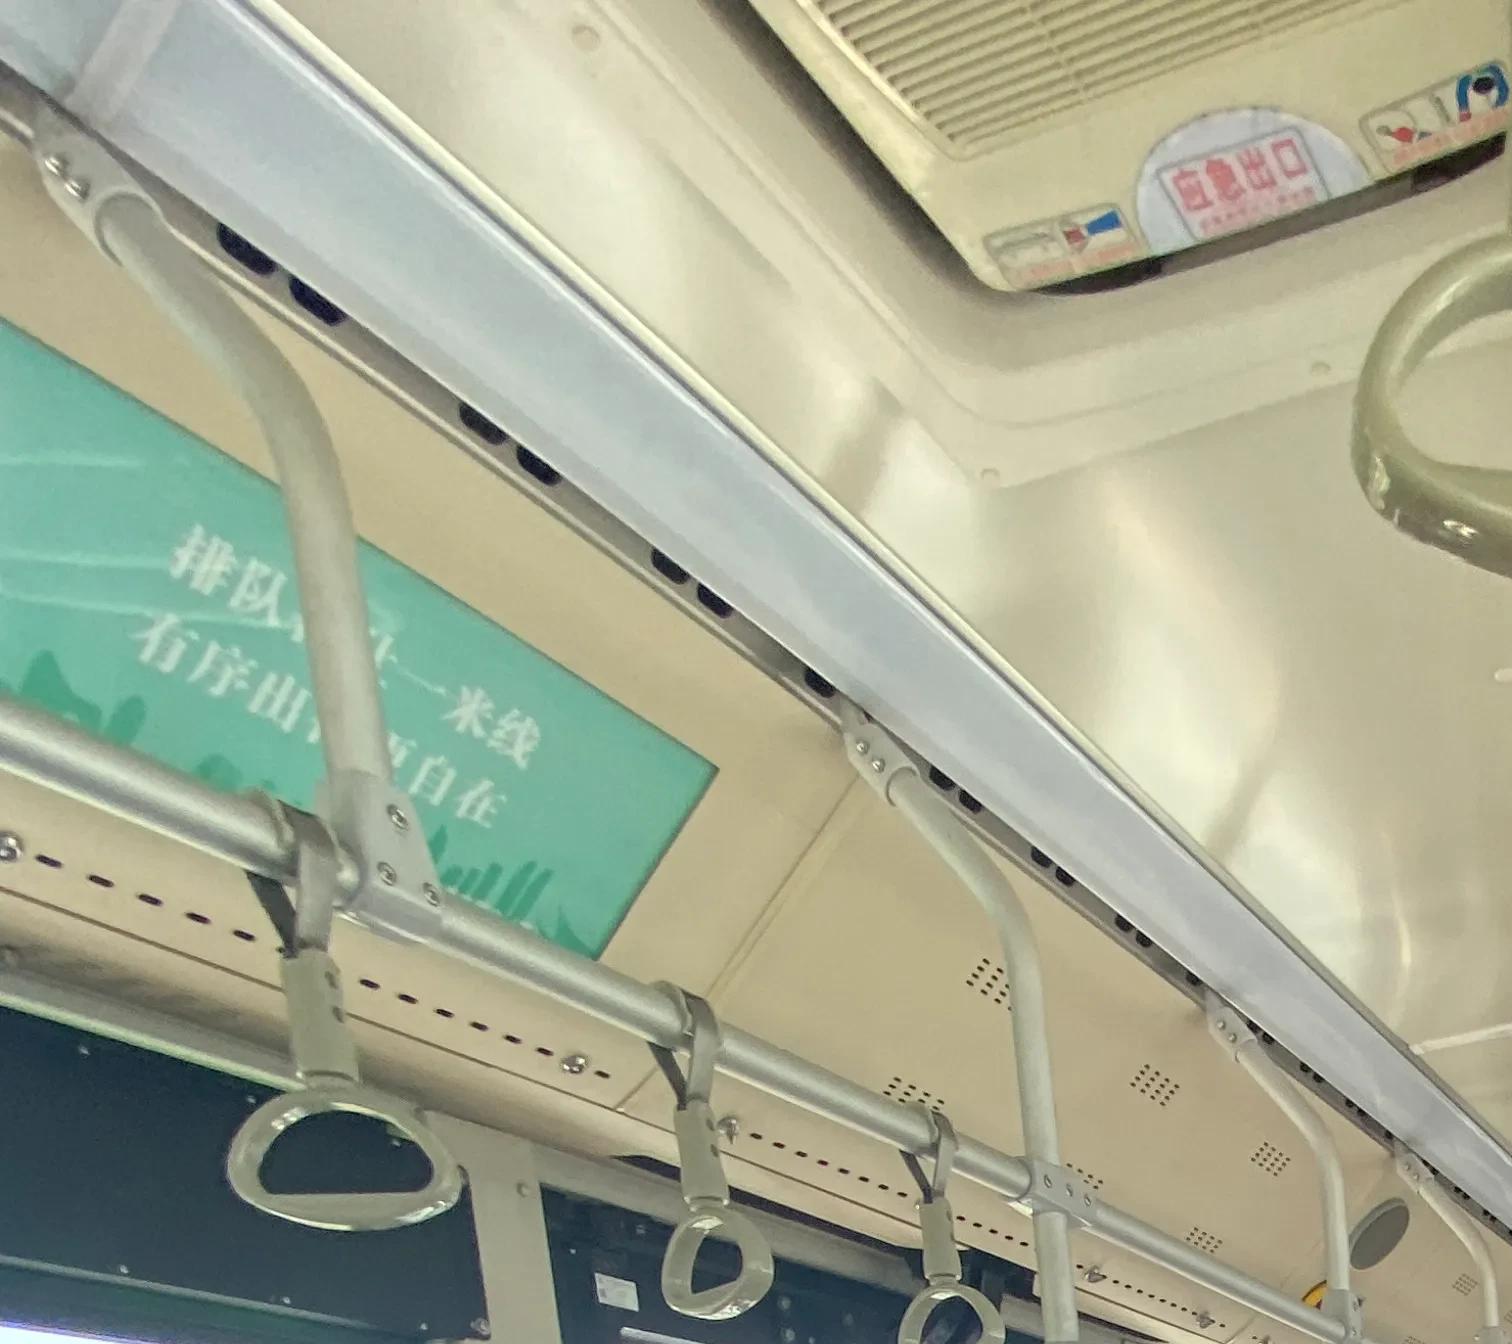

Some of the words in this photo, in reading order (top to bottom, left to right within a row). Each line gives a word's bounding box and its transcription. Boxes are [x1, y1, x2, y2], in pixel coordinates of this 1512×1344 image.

[131, 611, 507, 829] 有序出自在
[169, 523, 541, 770] 排队一米线
